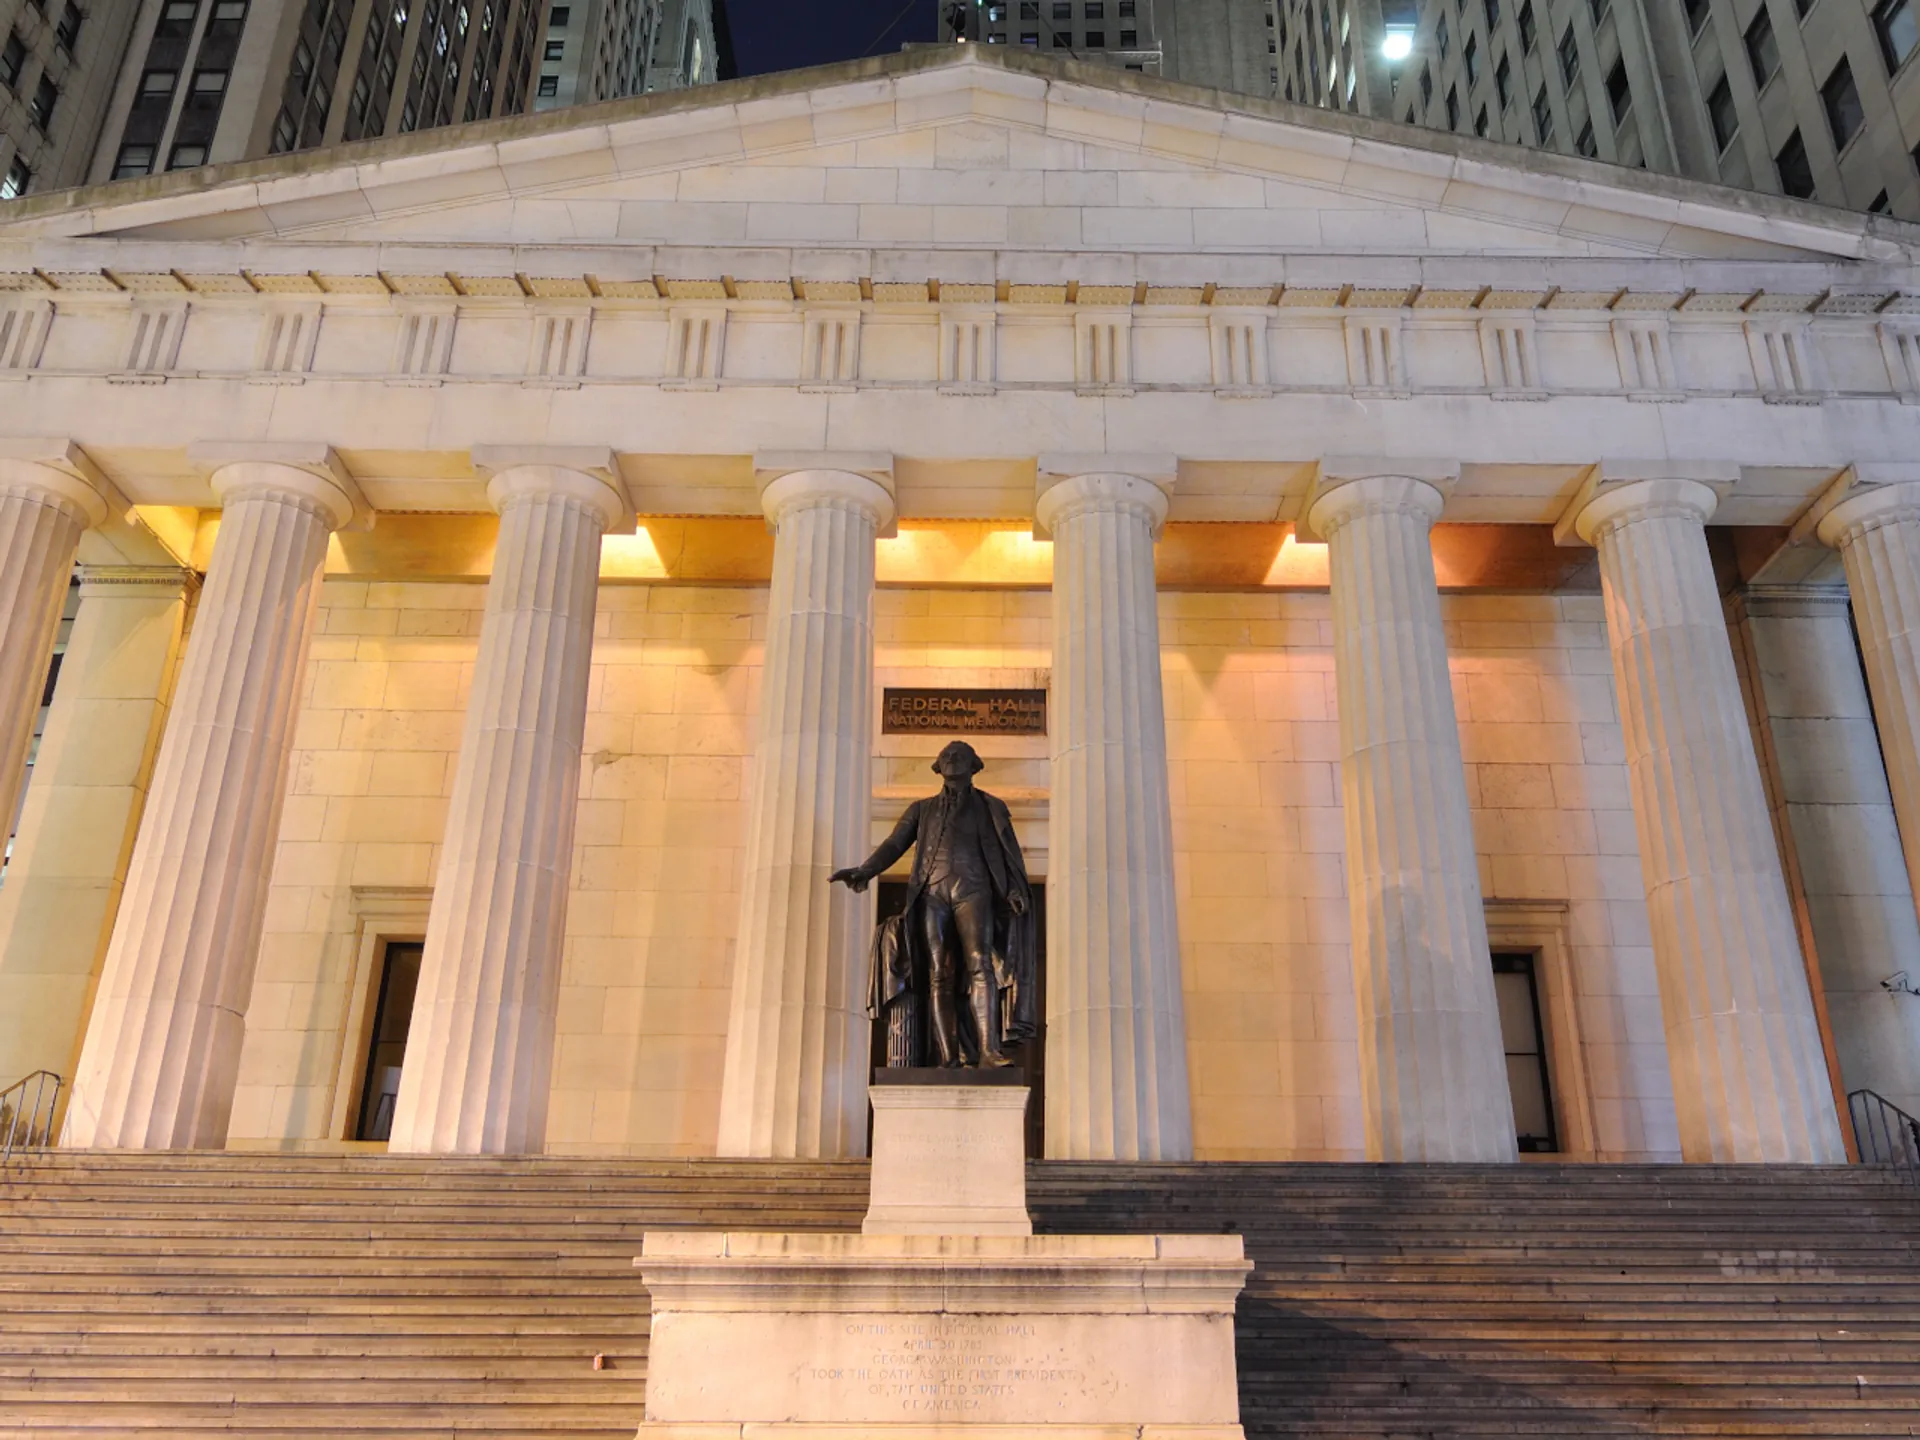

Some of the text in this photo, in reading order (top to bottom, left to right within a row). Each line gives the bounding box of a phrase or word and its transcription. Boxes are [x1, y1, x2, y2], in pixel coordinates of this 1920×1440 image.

[888, 697, 1041, 712] FEDERAL HALL
[887, 714, 957, 727] NATIONAL
[810, 1368, 845, 1380] TOOK
[849, 1368, 873, 1380] THE
[919, 1368, 935, 1380] AS
